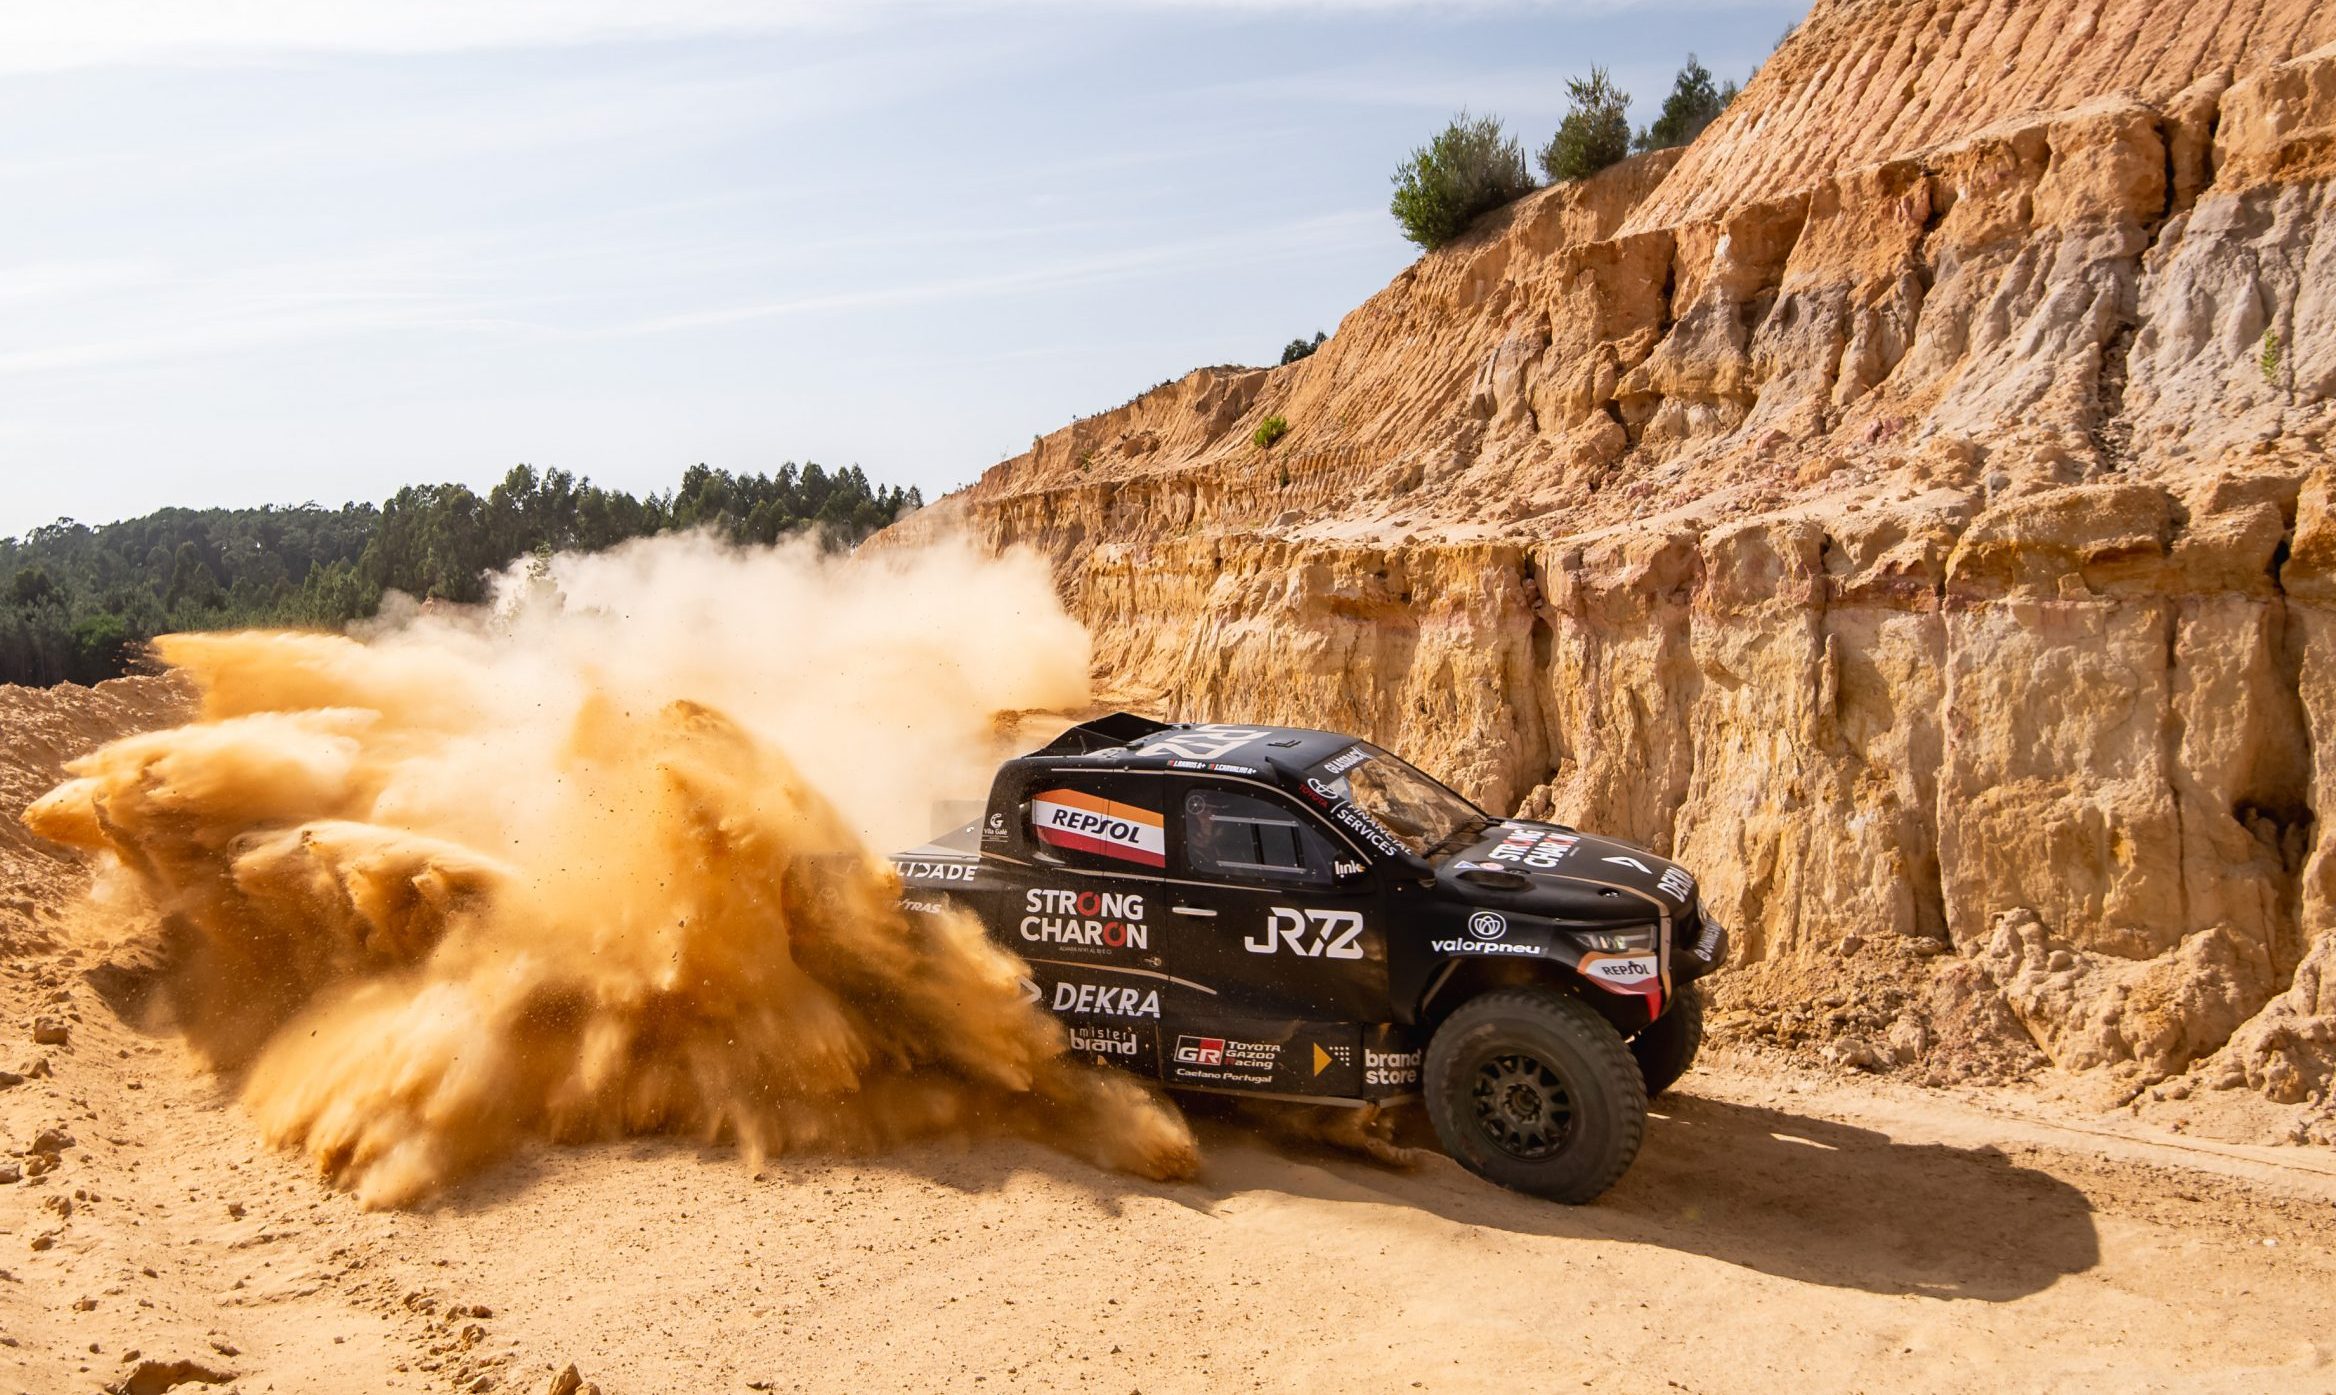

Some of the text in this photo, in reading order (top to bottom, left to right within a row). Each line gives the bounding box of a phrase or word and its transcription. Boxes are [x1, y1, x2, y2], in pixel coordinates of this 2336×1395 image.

[1052, 809, 1141, 844] REPSOL
[1337, 809, 1398, 856] SERVICES
[1348, 802, 1412, 855] FINANCIAL
[1487, 829, 1546, 862] STRONG
[1523, 832, 1581, 868] CHARON
[1026, 888, 1144, 920] STRONG
[1020, 916, 1147, 949] CHARON
[1244, 907, 1364, 959] JR72
[1431, 938, 1541, 954] valorpneu
[1601, 961, 1650, 976] REPSOL
[1052, 982, 1161, 1018] DEKRA
[1070, 1028, 1137, 1055] brand
[1080, 1026, 1128, 1040] mister
[1178, 1047, 1220, 1063] GR
[1225, 1050, 1275, 1060] GAZOO
[1228, 1041, 1281, 1052] TOYOTA
[1225, 1058, 1273, 1070] Racing
[1365, 1049, 1421, 1067] brand
[1177, 1068, 1272, 1084] Caetano Portugal
[1366, 1068, 1417, 1085] store
